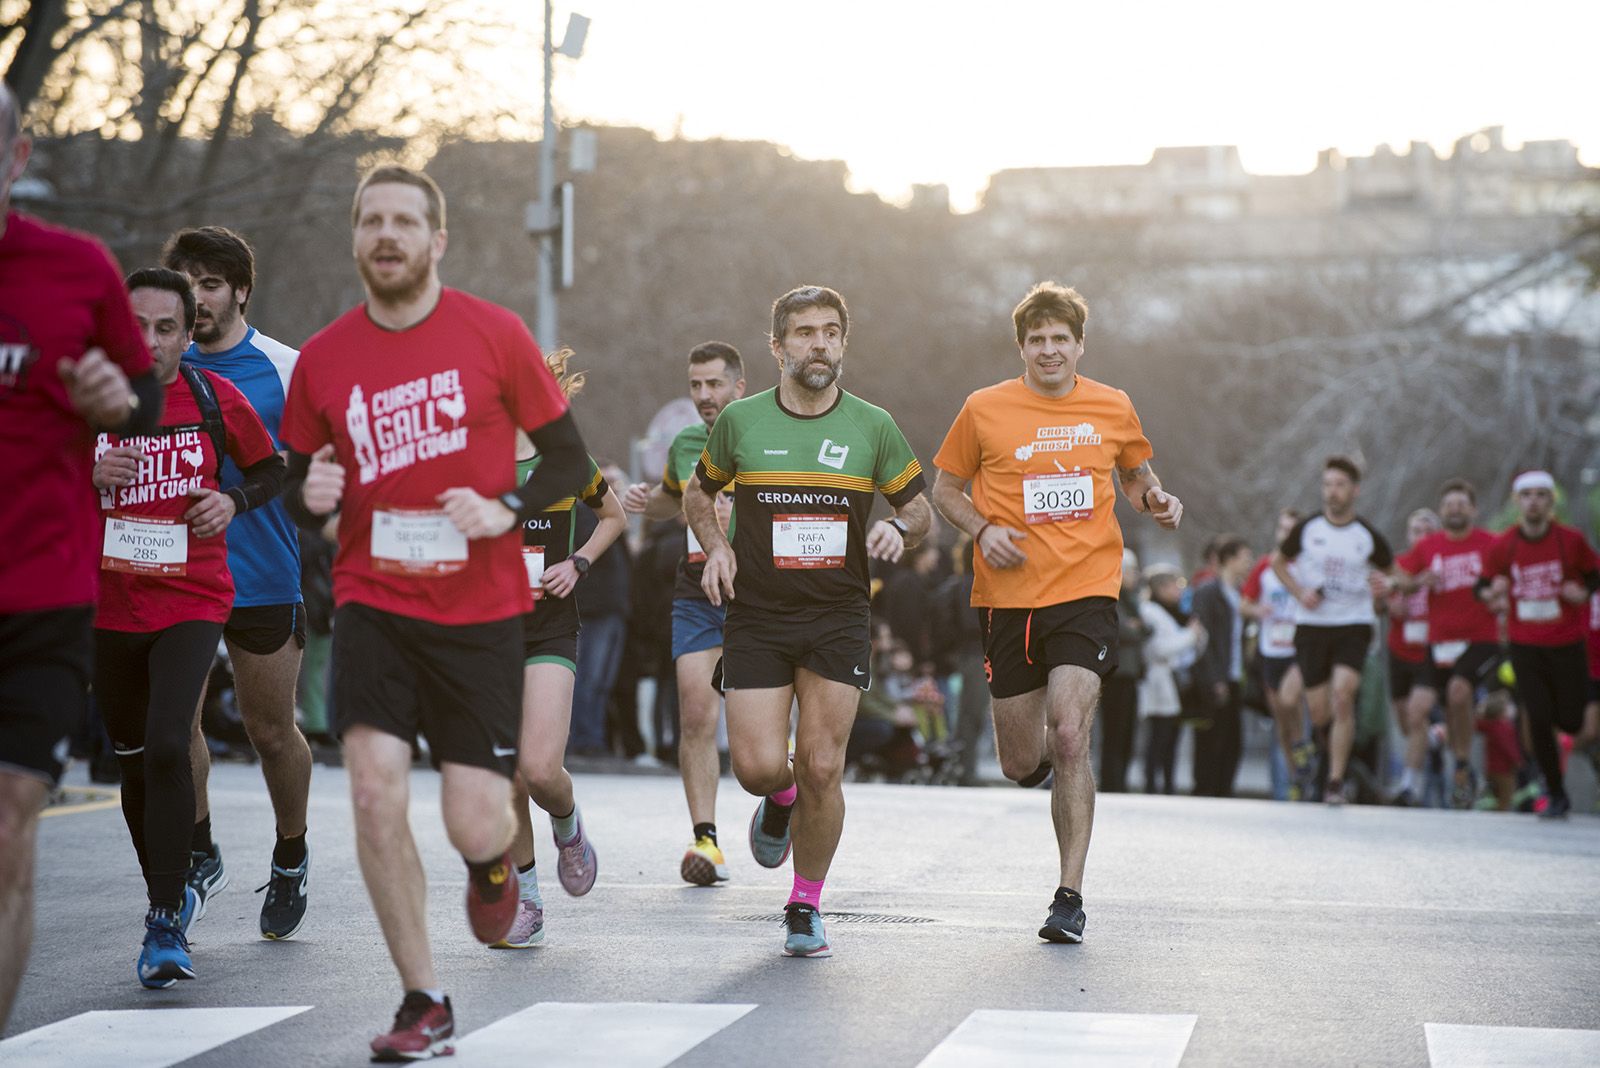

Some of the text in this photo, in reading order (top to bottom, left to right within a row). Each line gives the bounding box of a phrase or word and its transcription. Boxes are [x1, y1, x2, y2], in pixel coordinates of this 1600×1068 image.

[372, 367, 464, 417] CURSA DEL
[374, 399, 443, 452] GALL
[1038, 426, 1077, 439] CROSS
[175, 431, 201, 448] DEL
[380, 426, 468, 476] SANT CUGAT
[128, 450, 182, 485] ALL
[119, 475, 204, 506] SANT CUGAT
[1033, 488, 1086, 510] 3030
[757, 491, 850, 508] CERDANYOLA
[118, 533, 175, 548] ANTONIO
[797, 532, 826, 543] RAFA
[133, 547, 159, 561] 285
[801, 543, 822, 556] 159
